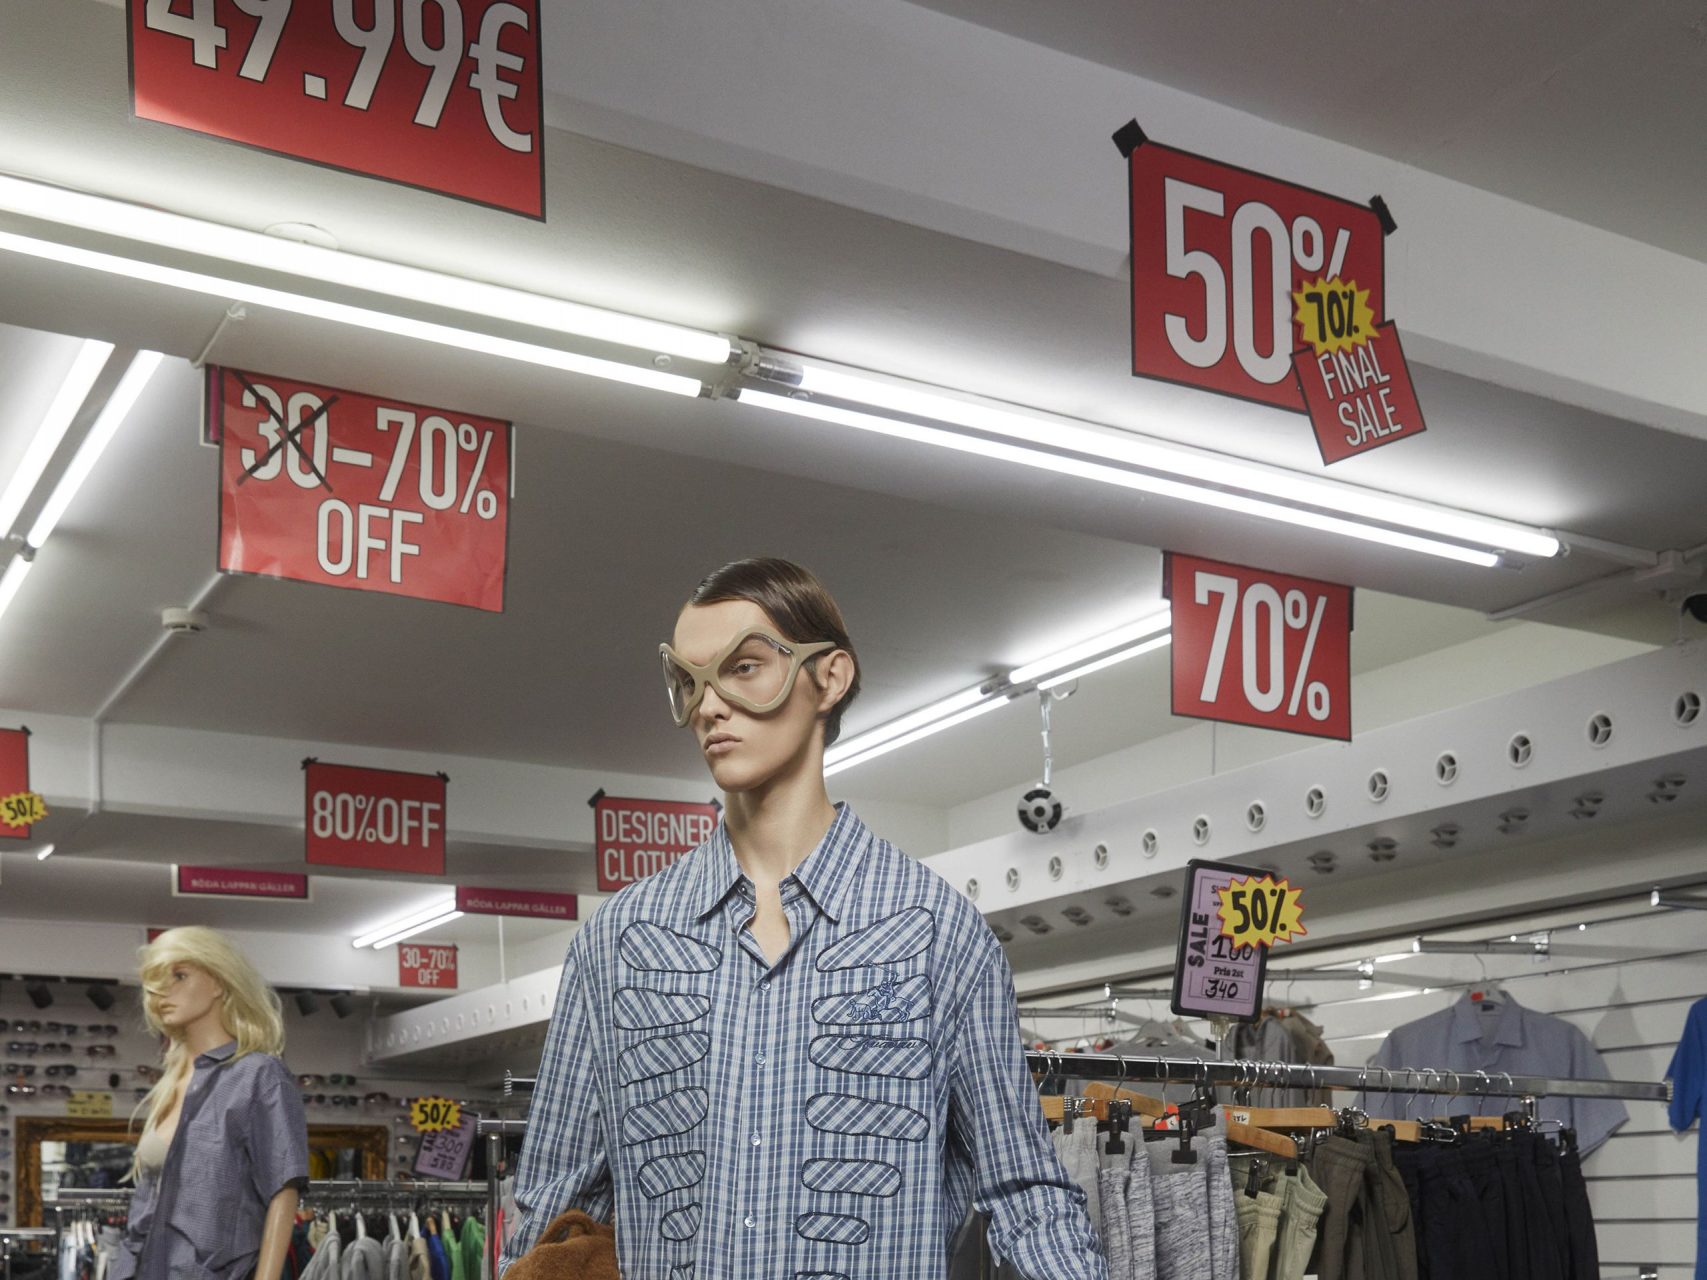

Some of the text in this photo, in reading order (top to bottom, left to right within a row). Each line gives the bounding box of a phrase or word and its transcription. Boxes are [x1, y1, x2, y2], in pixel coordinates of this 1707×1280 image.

[1305, 290, 1359, 343] 70%
[1318, 340, 1390, 400] FINAL
[1338, 388, 1402, 446] SALE
[317, 498, 424, 584] OFF
[1195, 571, 1331, 721] 70%
[4, 797, 39, 821] 50%
[602, 809, 714, 847] DESIGNER
[1231, 888, 1287, 934] 50%
[1188, 912, 1209, 968] SALE
[418, 968, 440, 986] OFF
[1205, 979, 1238, 999] 340
[418, 1103, 452, 1126] 50%
